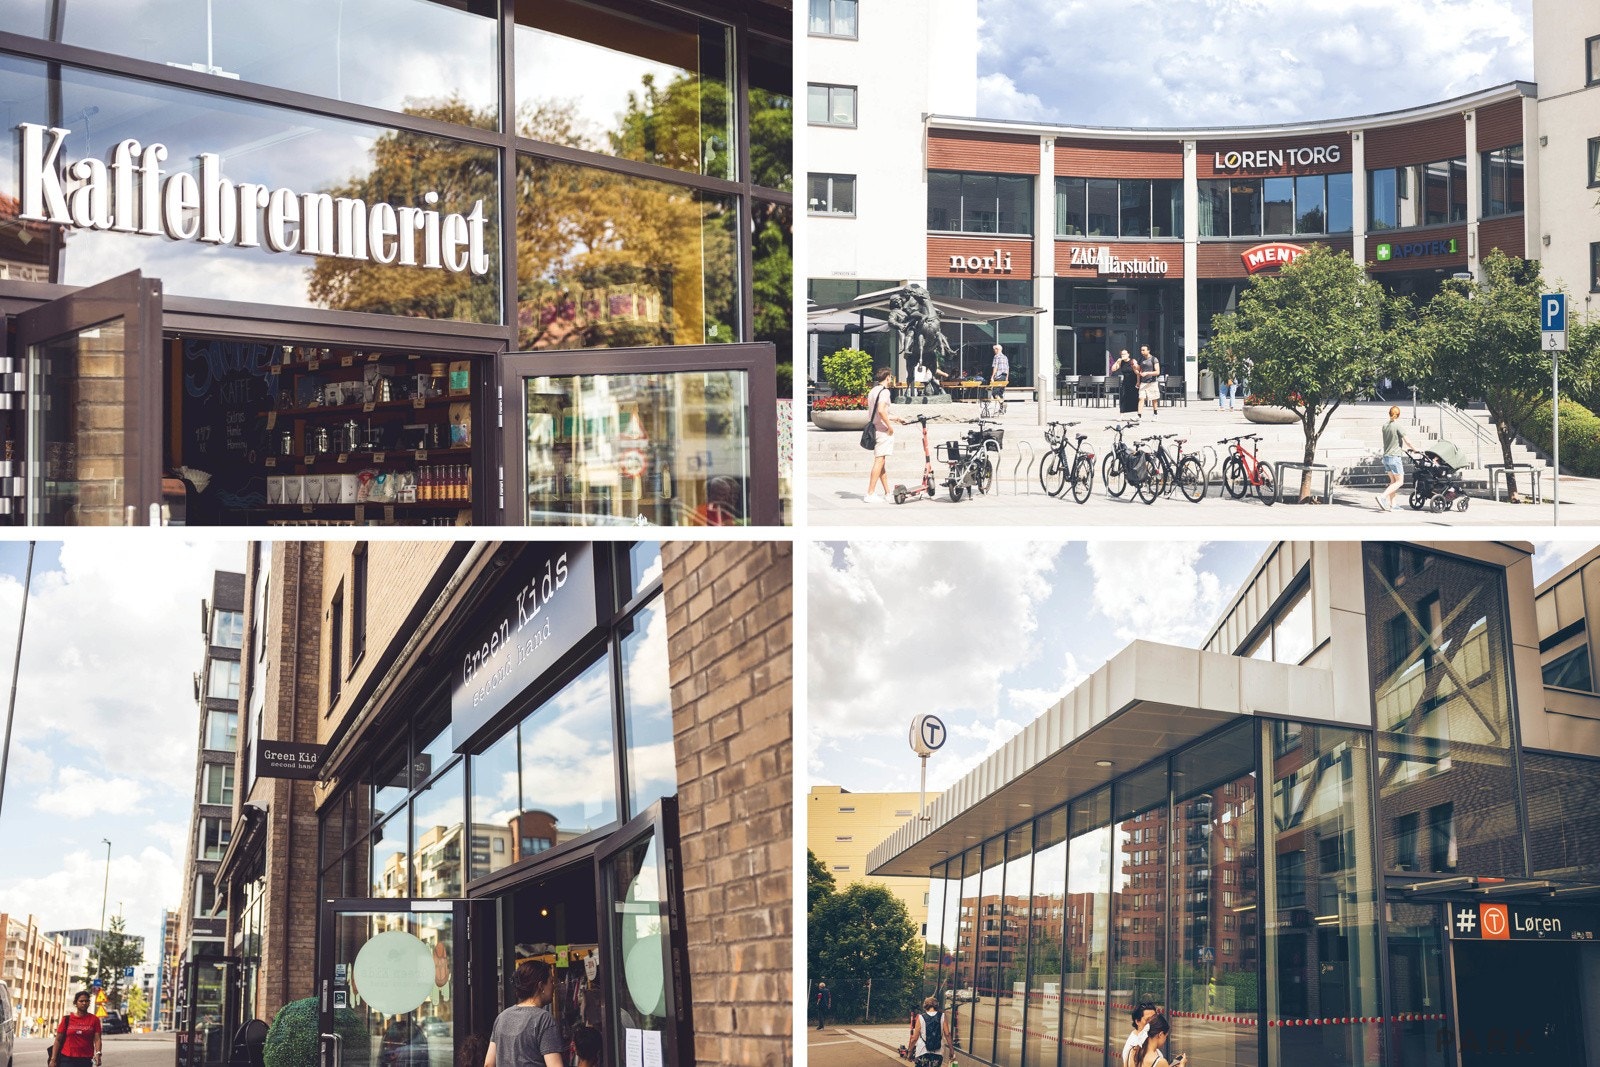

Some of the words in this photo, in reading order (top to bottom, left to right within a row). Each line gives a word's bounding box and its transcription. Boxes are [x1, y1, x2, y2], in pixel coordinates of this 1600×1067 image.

[1214, 148, 1284, 170] LØREN
[1286, 144, 1341, 166] TORG
[17, 121, 490, 276] Kaffebrenneriet
[949, 249, 1013, 272] norli
[1070, 246, 1106, 266] ZAGA
[1104, 255, 1169, 275] Hårstudio
[1547, 299, 1560, 327] P
[219, 377, 254, 405] KAFFE
[463, 618, 511, 687] Green
[516, 551, 569, 634] Kids
[472, 653, 513, 708] second
[516, 616, 552, 667] hand
[264, 749, 296, 761] Green
[298, 752, 318, 763] Kid
[1514, 911, 1562, 932] Løren
